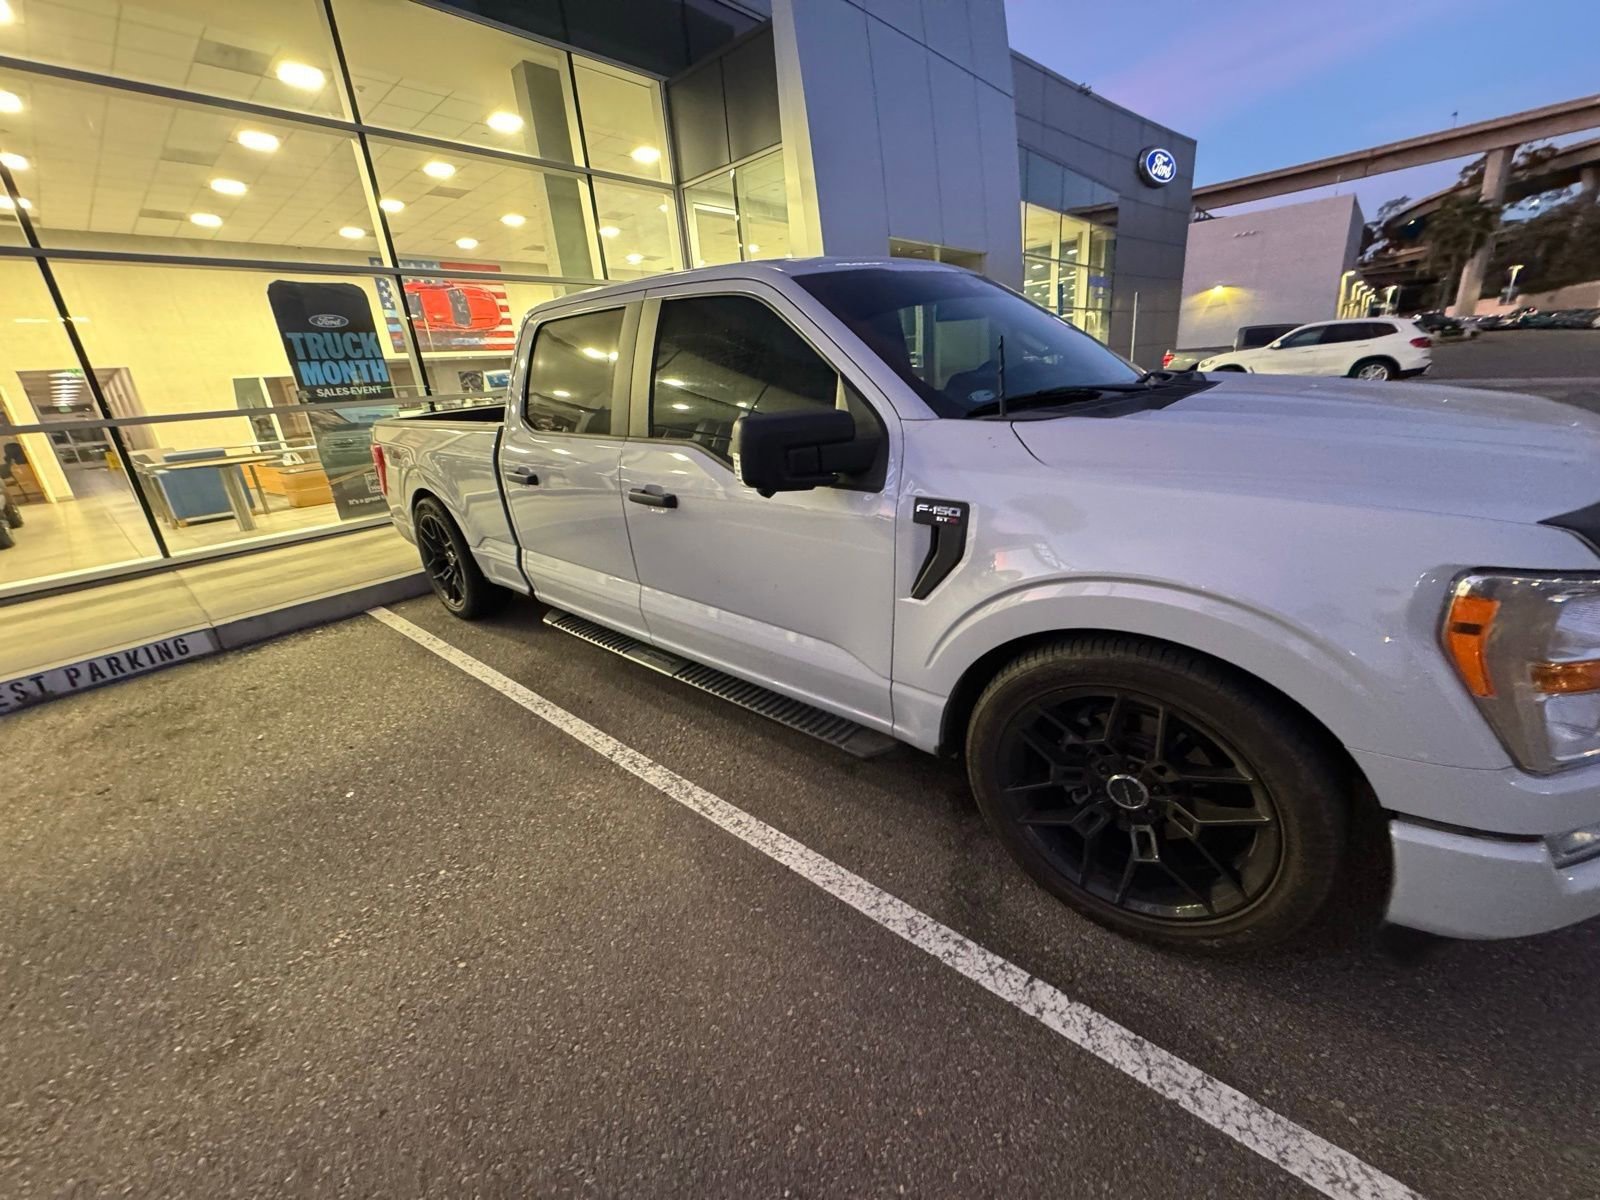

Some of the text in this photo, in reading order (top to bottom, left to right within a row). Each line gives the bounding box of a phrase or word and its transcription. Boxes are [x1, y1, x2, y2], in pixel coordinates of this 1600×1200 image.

[285, 332, 382, 359] TRUCK
[298, 359, 389, 386] MONTH
[316, 385, 382, 398] SALES EVENT
[916, 504, 961, 517] F-150
[64, 637, 190, 687] PARKING
